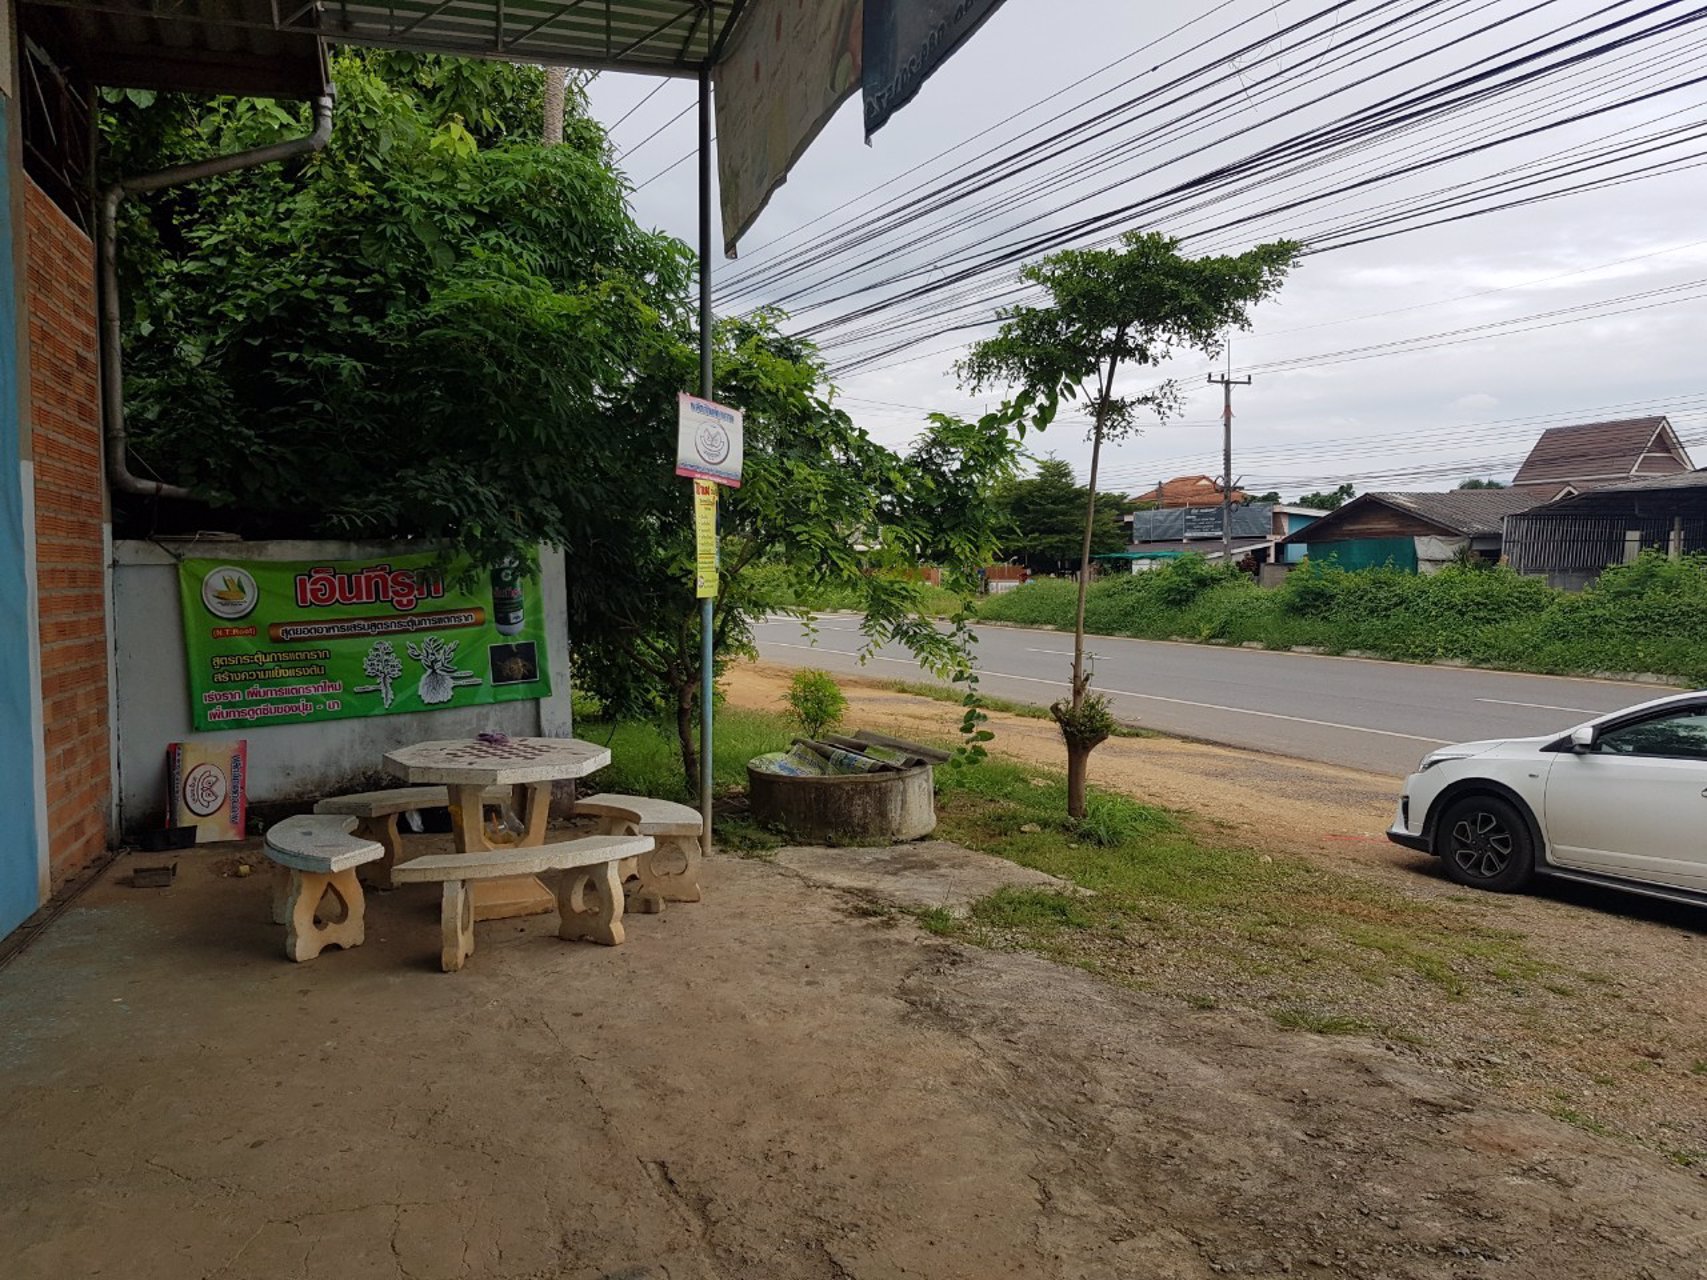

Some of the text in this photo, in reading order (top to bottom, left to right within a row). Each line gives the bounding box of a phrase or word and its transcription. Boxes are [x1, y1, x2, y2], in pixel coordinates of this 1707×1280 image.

[212, 650, 330, 668] สูตรกระตุ้นการแตกราก
